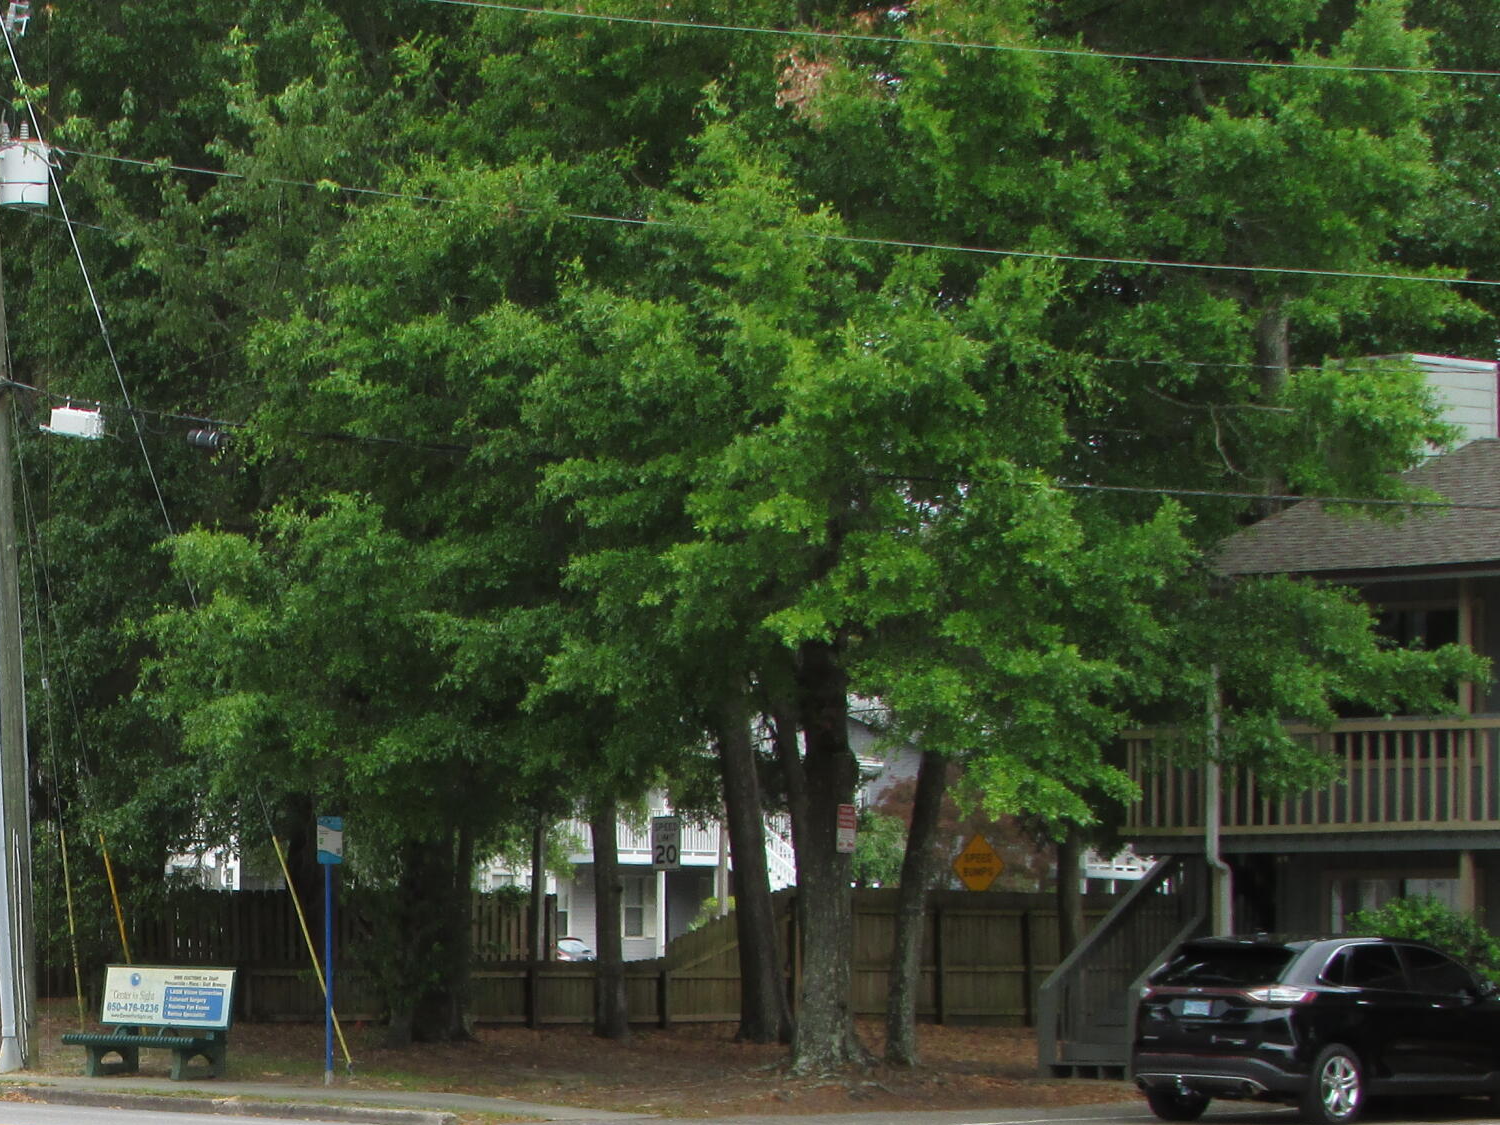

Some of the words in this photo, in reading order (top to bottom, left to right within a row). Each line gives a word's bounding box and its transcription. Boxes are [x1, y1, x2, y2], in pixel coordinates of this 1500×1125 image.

[655, 822, 677, 832] SPEED
[655, 844, 677, 864] 20
[964, 853, 993, 864] SPEED
[963, 866, 994, 878] BUMPS
